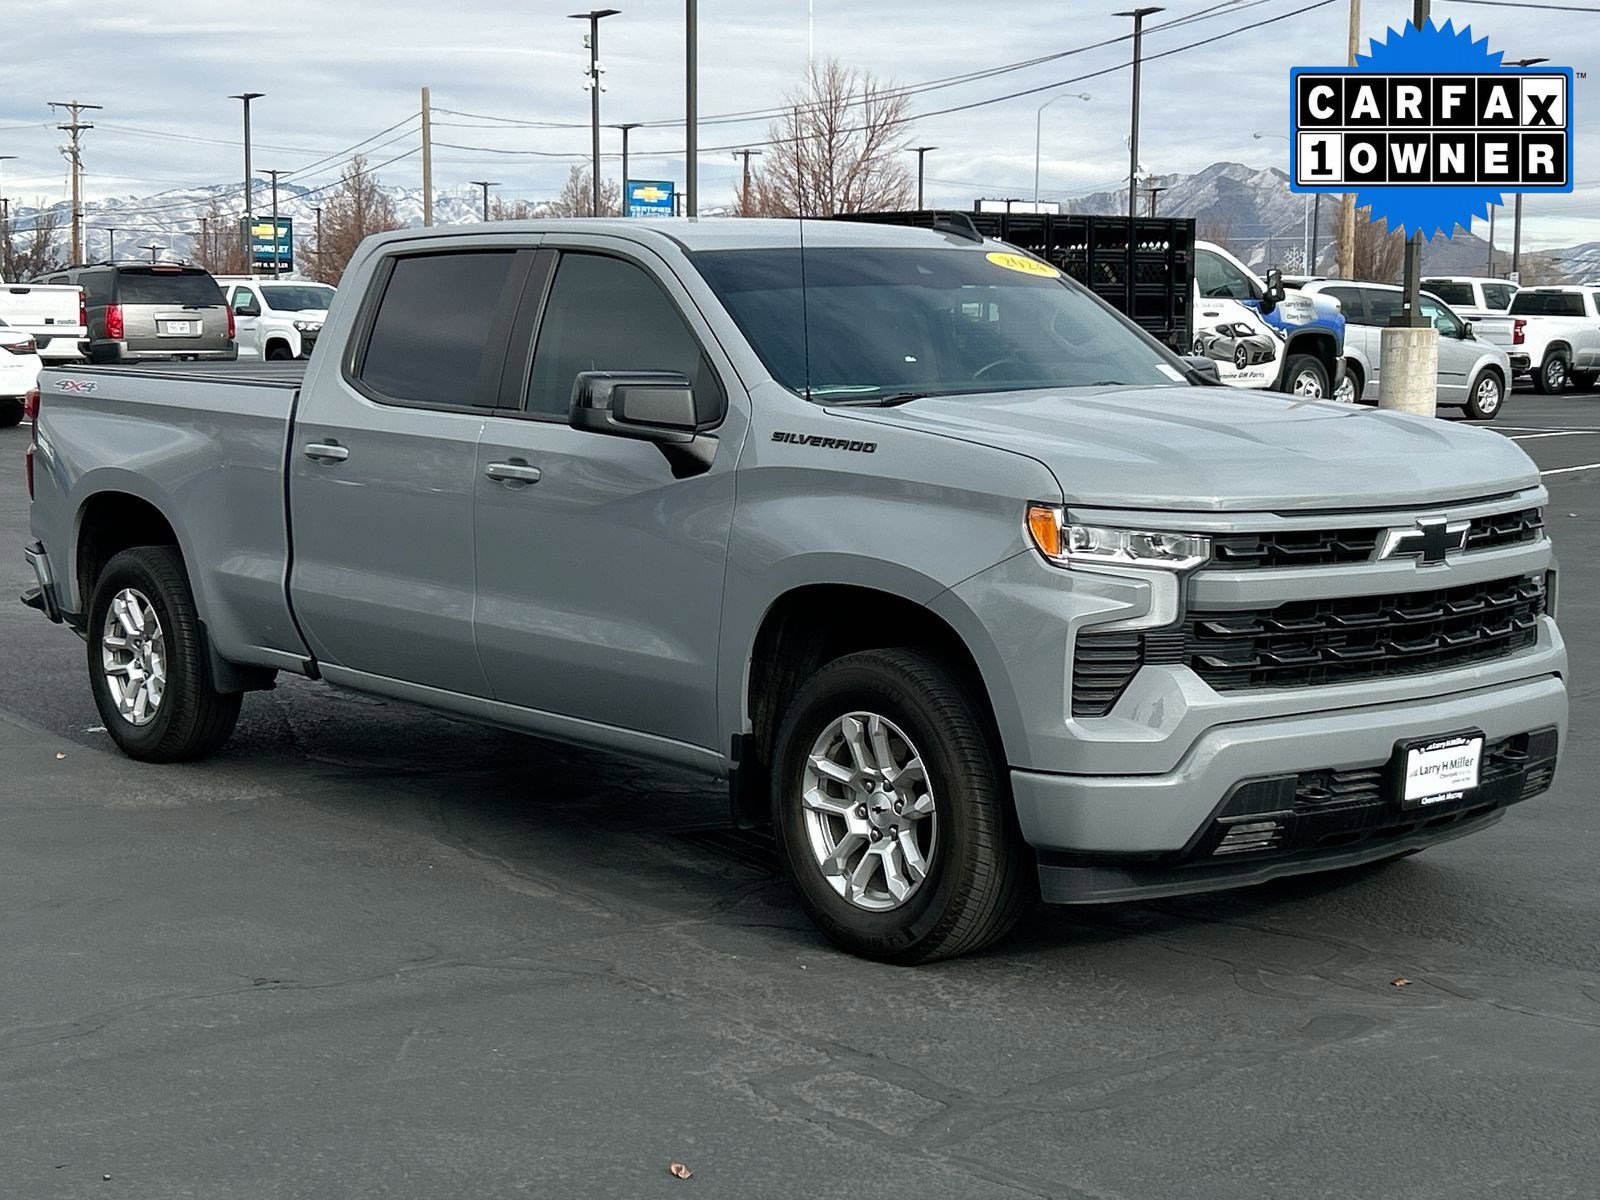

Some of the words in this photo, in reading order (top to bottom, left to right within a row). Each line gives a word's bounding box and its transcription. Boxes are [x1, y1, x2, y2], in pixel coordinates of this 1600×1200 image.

[771, 431, 878, 453] SILVERADO
[1420, 764, 1440, 776] Larry
[1442, 761, 1448, 771] H
[1450, 756, 1474, 769] Miller
